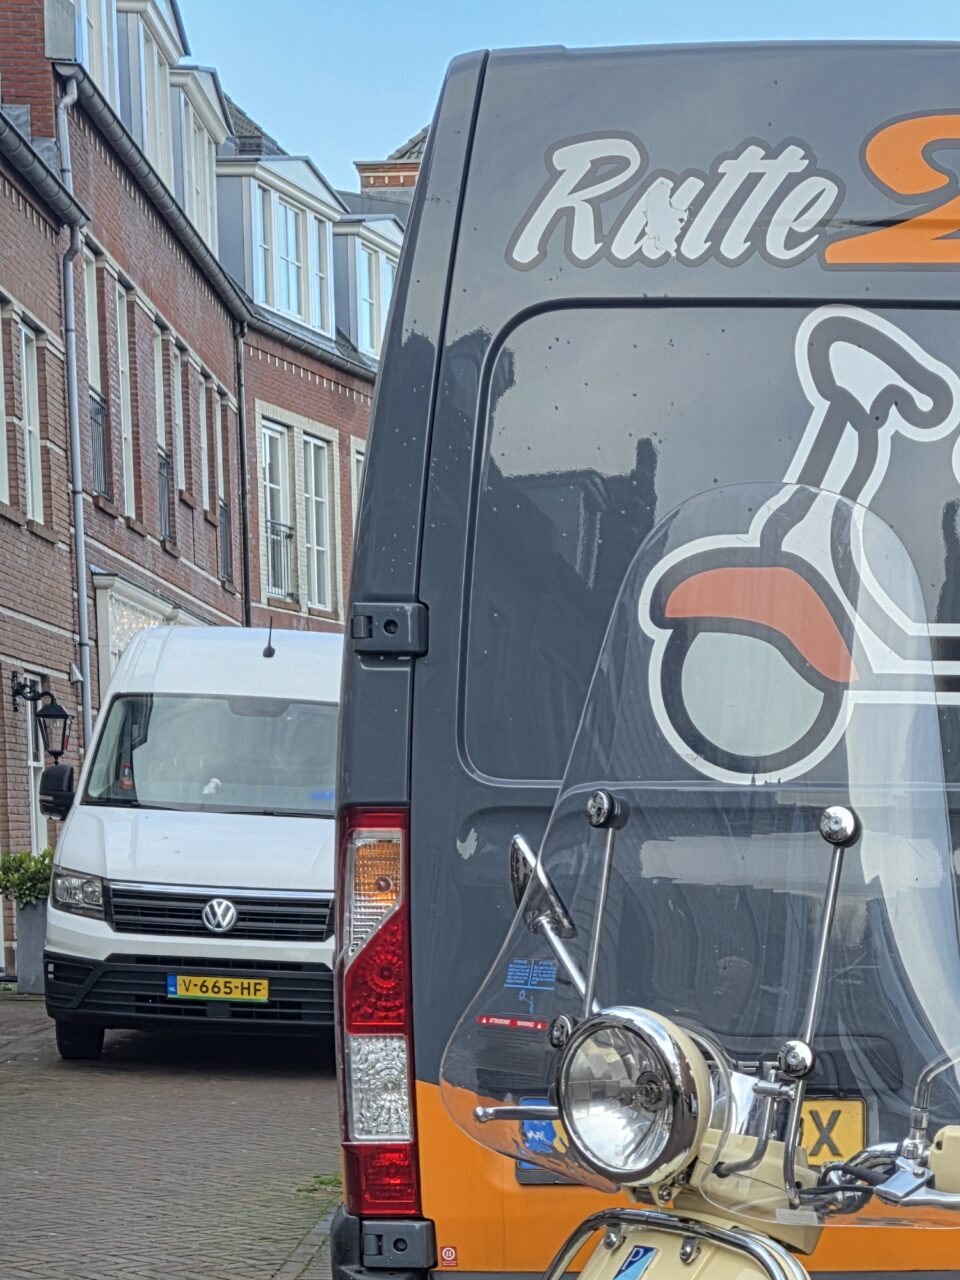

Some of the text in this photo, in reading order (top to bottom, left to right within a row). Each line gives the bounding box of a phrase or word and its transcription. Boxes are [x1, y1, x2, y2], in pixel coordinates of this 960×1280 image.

[182, 978, 263, 997] V-665-HF
[800, 1110, 843, 1158] X
[621, 1247, 645, 1271] P
